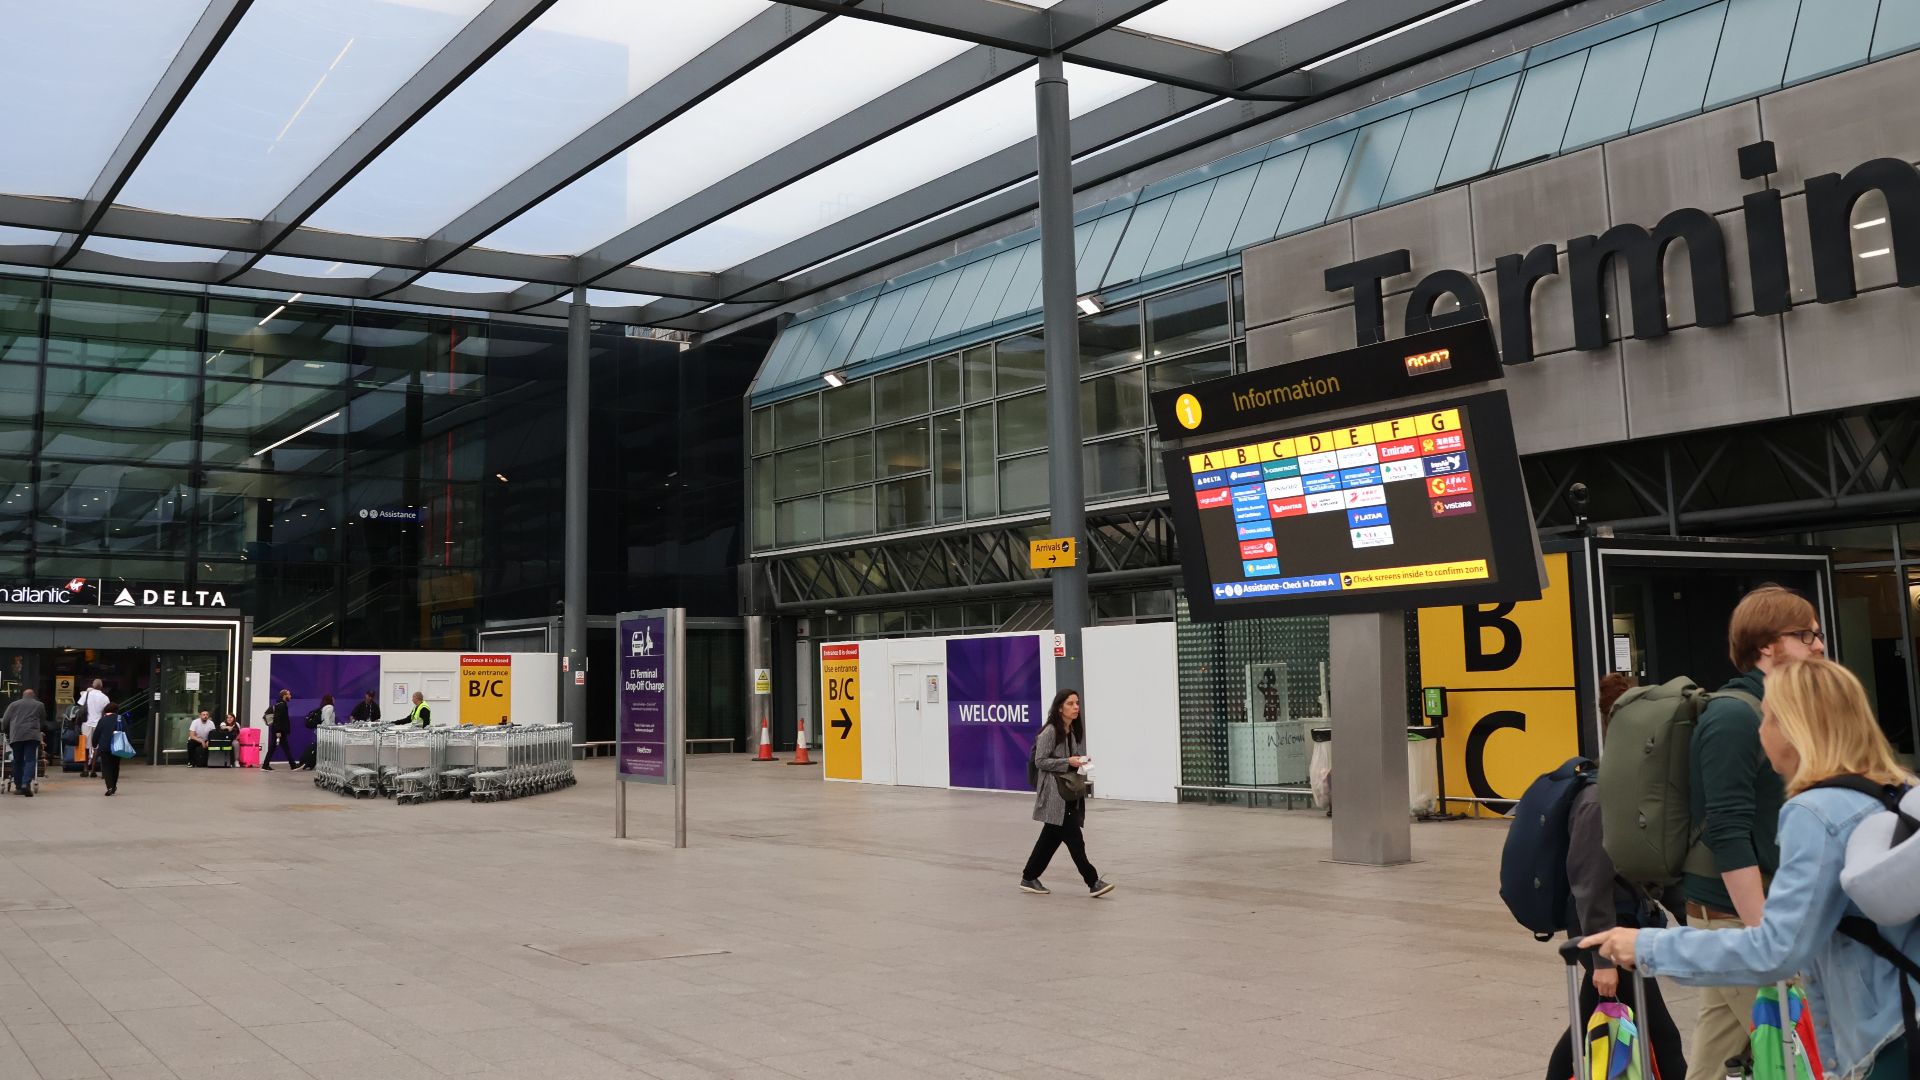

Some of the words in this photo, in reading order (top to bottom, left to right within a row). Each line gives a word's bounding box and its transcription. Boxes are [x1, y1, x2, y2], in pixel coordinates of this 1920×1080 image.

[1232, 376, 1340, 411] Information
[1203, 455, 1213, 469] A
[1237, 449, 1246, 464] B
[1273, 442, 1283, 457] C
[1310, 436, 1321, 451] D
[1349, 429, 1358, 445] E
[1391, 421, 1400, 438] F
[1432, 413, 1444, 431] G
[1381, 444, 1414, 457] Emirates
[379, 510, 416, 519] Assistance
[1360, 512, 1383, 521] LATAM
[1036, 543, 1061, 552] Arrivals
[1353, 574, 1373, 583] Check
[1375, 573, 1401, 582] screens
[1402, 571, 1424, 579] inside
[1435, 567, 1464, 576] confirm
[1465, 566, 1484, 574] zone
[1283, 580, 1302, 589] Check
[1303, 580, 1309, 588] in
[1310, 579, 1327, 588] Zone
[1328, 578, 1334, 586] A
[11, 586, 70, 603] atlantic
[143, 589, 226, 607] DELTA
[1462, 601, 1523, 672] B
[636, 668, 657, 679] Terminal
[835, 665, 857, 673] entrance
[469, 680, 503, 697] B/C
[625, 680, 645, 693] Drop-Off
[645, 680, 664, 693] Charge
[829, 677, 854, 701] B/C
[959, 704, 1029, 723] WELCOME
[1465, 710, 1526, 816] C
